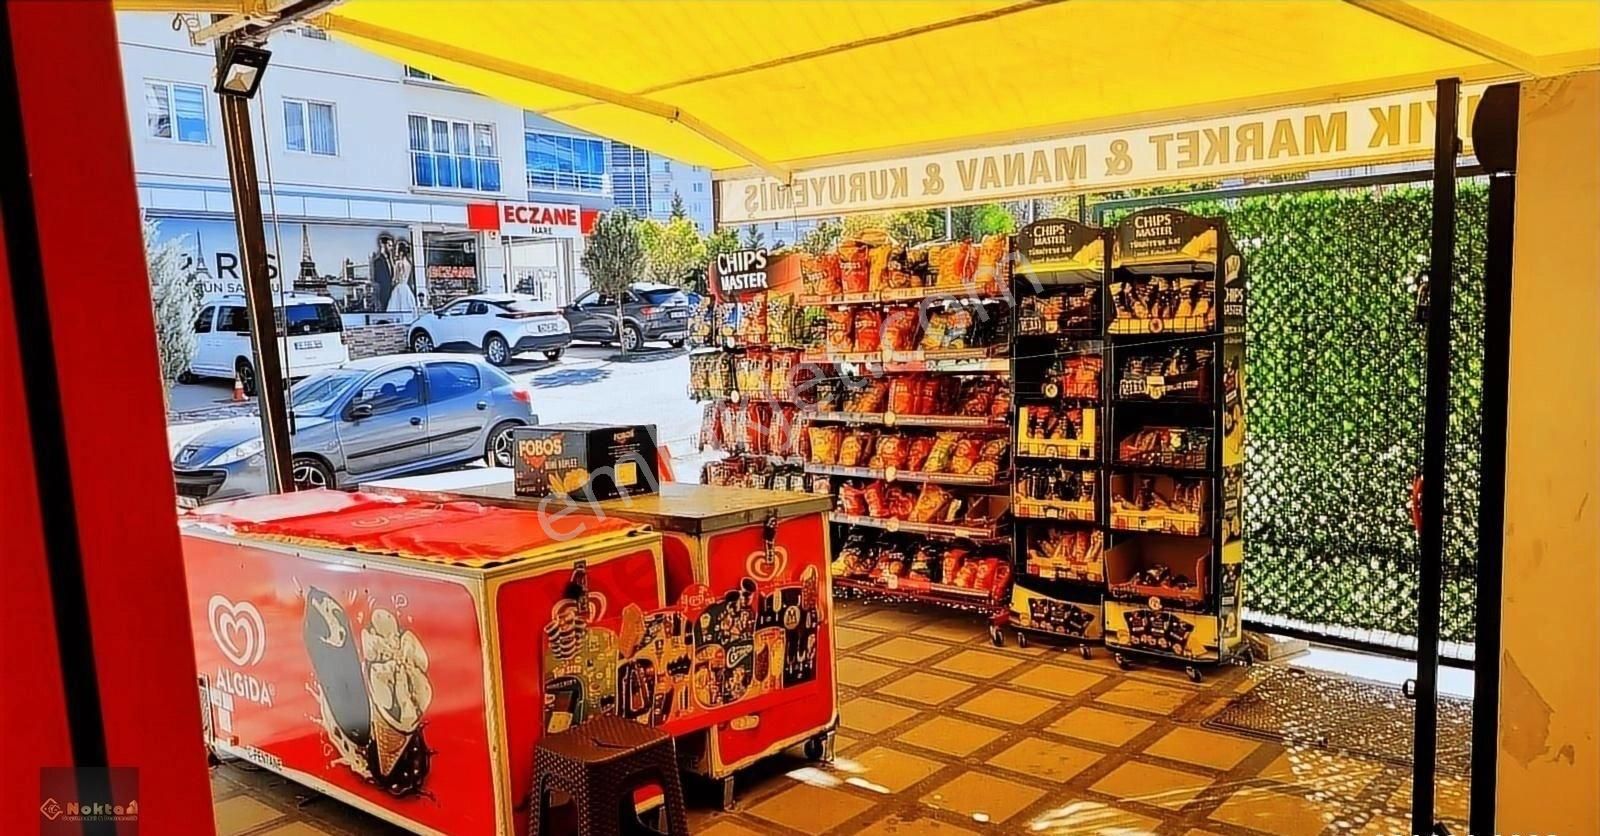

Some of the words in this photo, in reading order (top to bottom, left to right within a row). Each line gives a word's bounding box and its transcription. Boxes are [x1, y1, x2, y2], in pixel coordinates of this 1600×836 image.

[504, 205, 577, 226] ECZANE
[1134, 214, 1172, 229] CHIPS
[531, 226, 554, 235] NARE
[1033, 224, 1065, 237] CHIPS
[1135, 226, 1173, 238] MASTER
[1034, 236, 1066, 246] MASTER
[717, 249, 768, 275] CHIPS
[720, 271, 769, 291] MASTER
[518, 439, 562, 457] FOBOS
